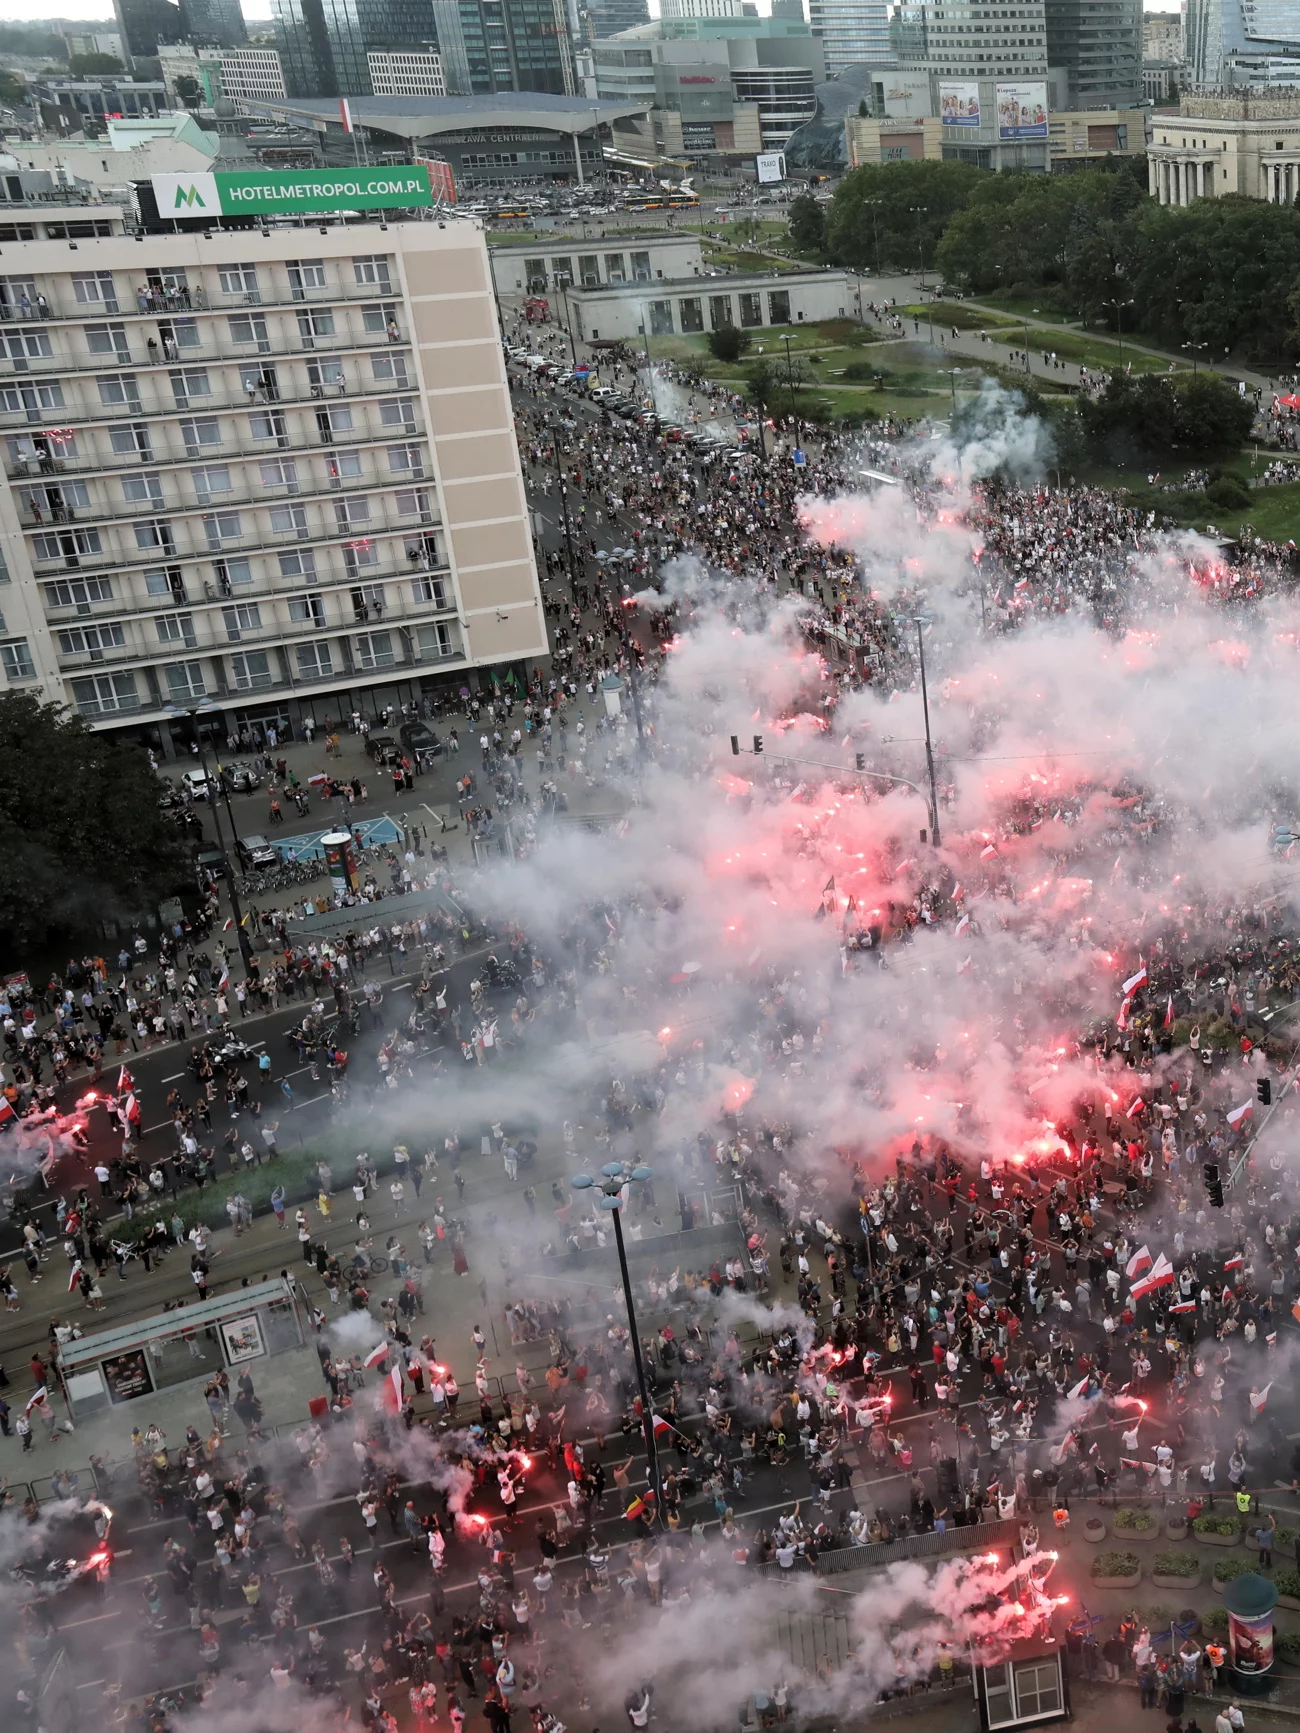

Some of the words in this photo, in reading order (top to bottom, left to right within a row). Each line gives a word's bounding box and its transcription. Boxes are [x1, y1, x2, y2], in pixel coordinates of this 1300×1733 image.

[434, 134, 487, 145] WARSZAWA
[490, 134, 545, 143] CENTRALNA
[229, 180, 425, 201] HOTELMETROPOL.COM.PL
